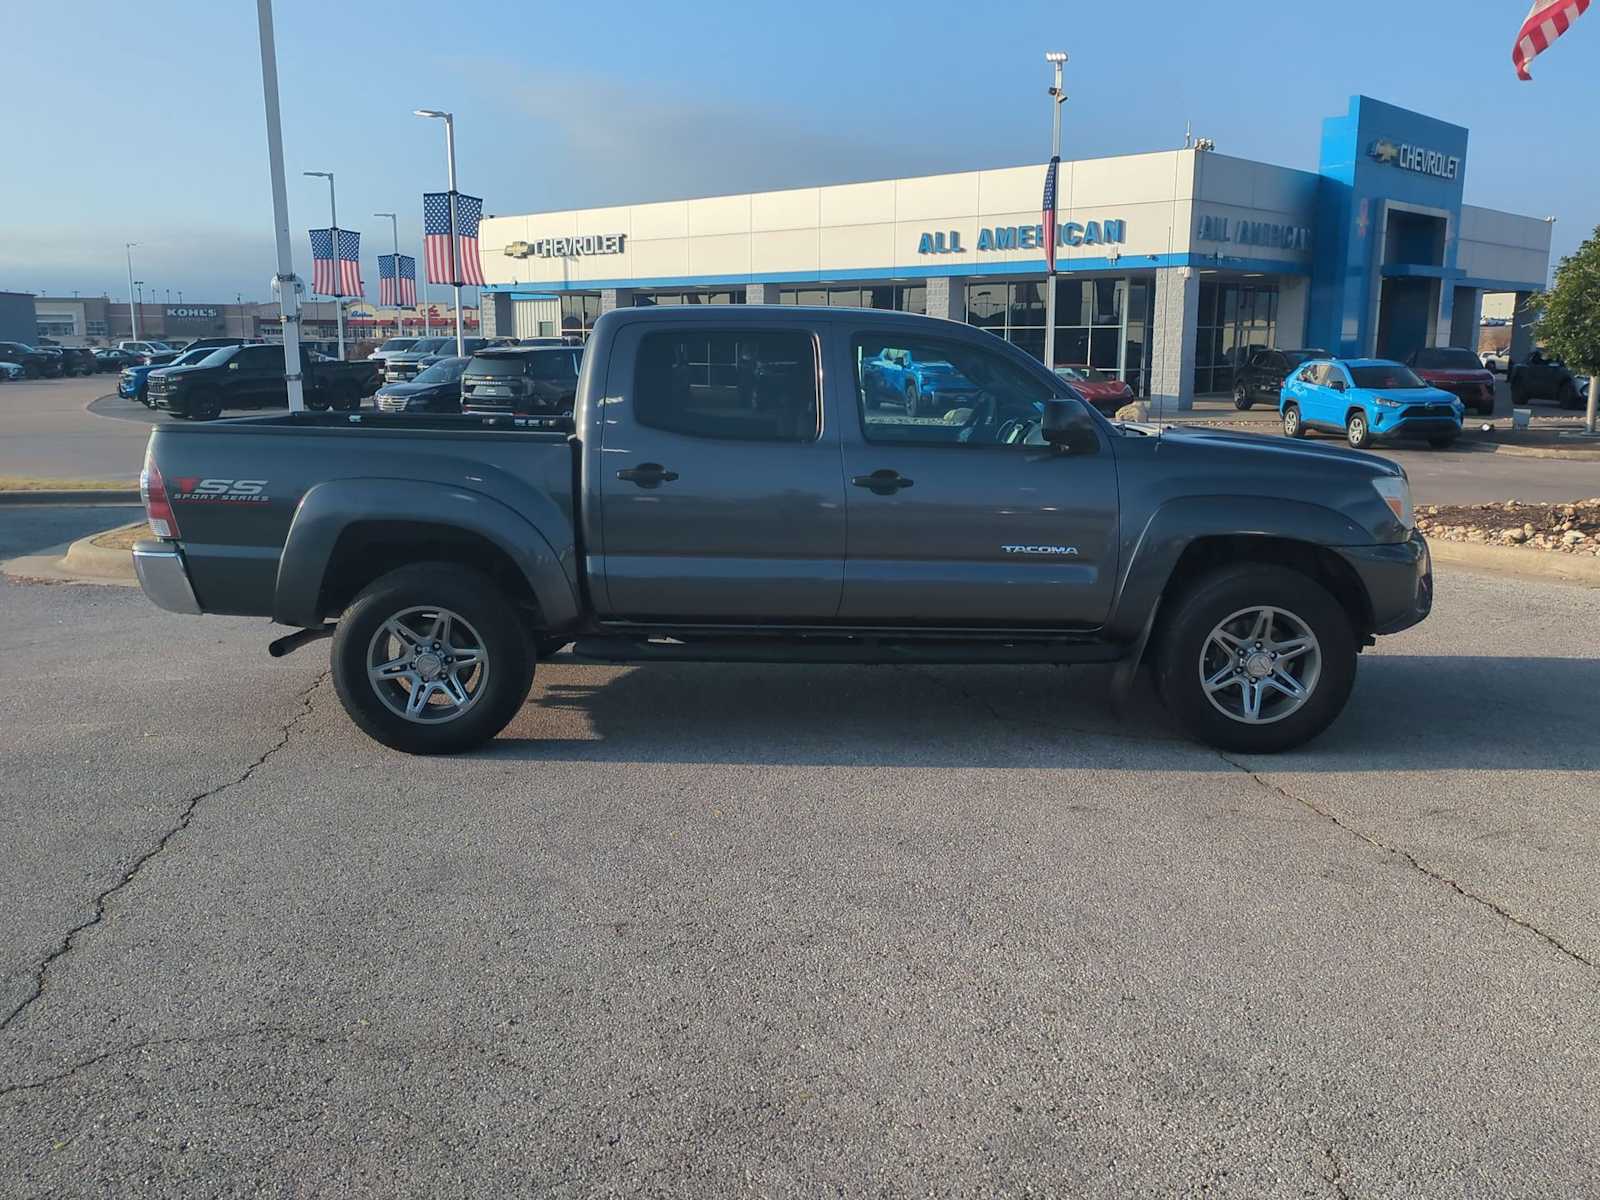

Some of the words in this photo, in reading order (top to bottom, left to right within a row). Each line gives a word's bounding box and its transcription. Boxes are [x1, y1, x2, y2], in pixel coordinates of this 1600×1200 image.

[1400, 143, 1460, 179] CHEVROLET
[1198, 215, 1230, 241] ALL
[534, 233, 626, 258] CHEVROLET
[918, 231, 967, 255] ALL
[167, 308, 217, 317] KOHL'S
[221, 494, 270, 502] SERIES
[1001, 545, 1079, 555] TACOMA
